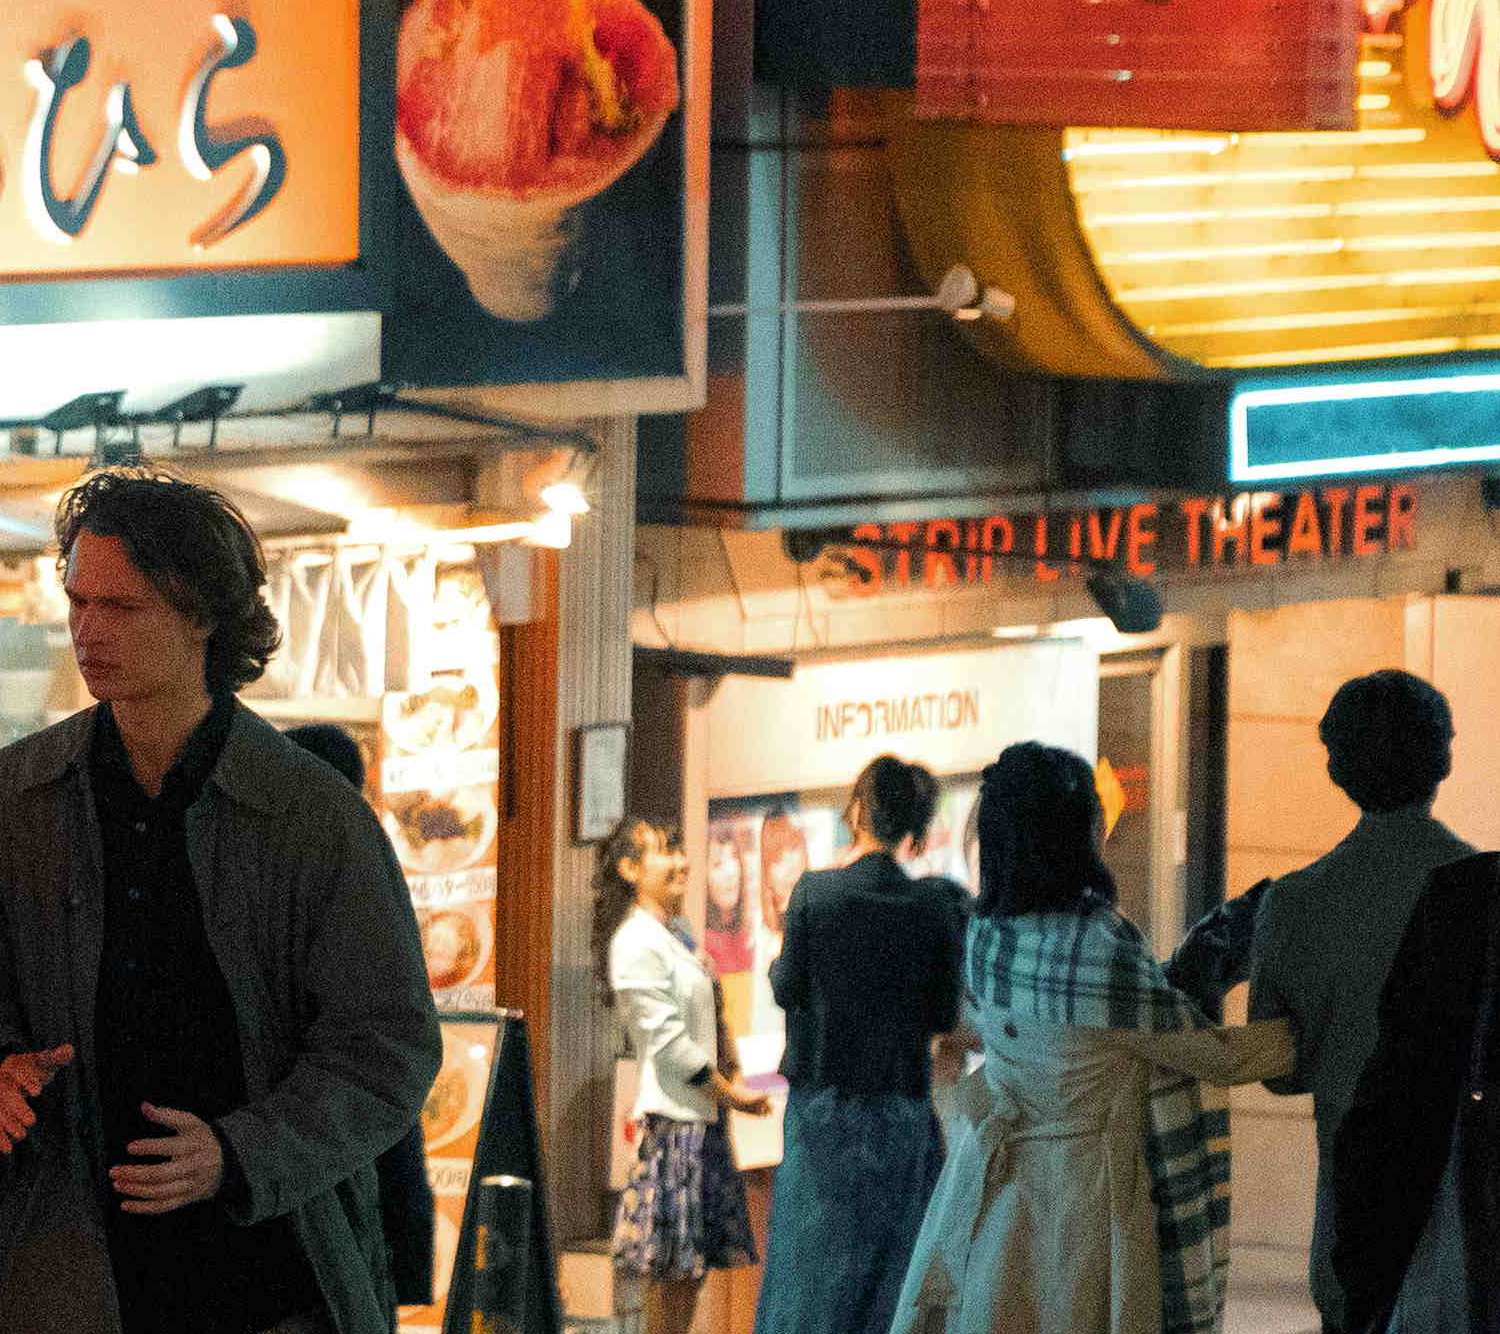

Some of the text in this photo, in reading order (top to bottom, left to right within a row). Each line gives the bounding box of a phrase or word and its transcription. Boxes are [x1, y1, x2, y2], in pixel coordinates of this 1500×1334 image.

[1034, 503, 1156, 580] LIVE
[1183, 483, 1420, 567] THEATER
[814, 687, 981, 743] INFORMATION
